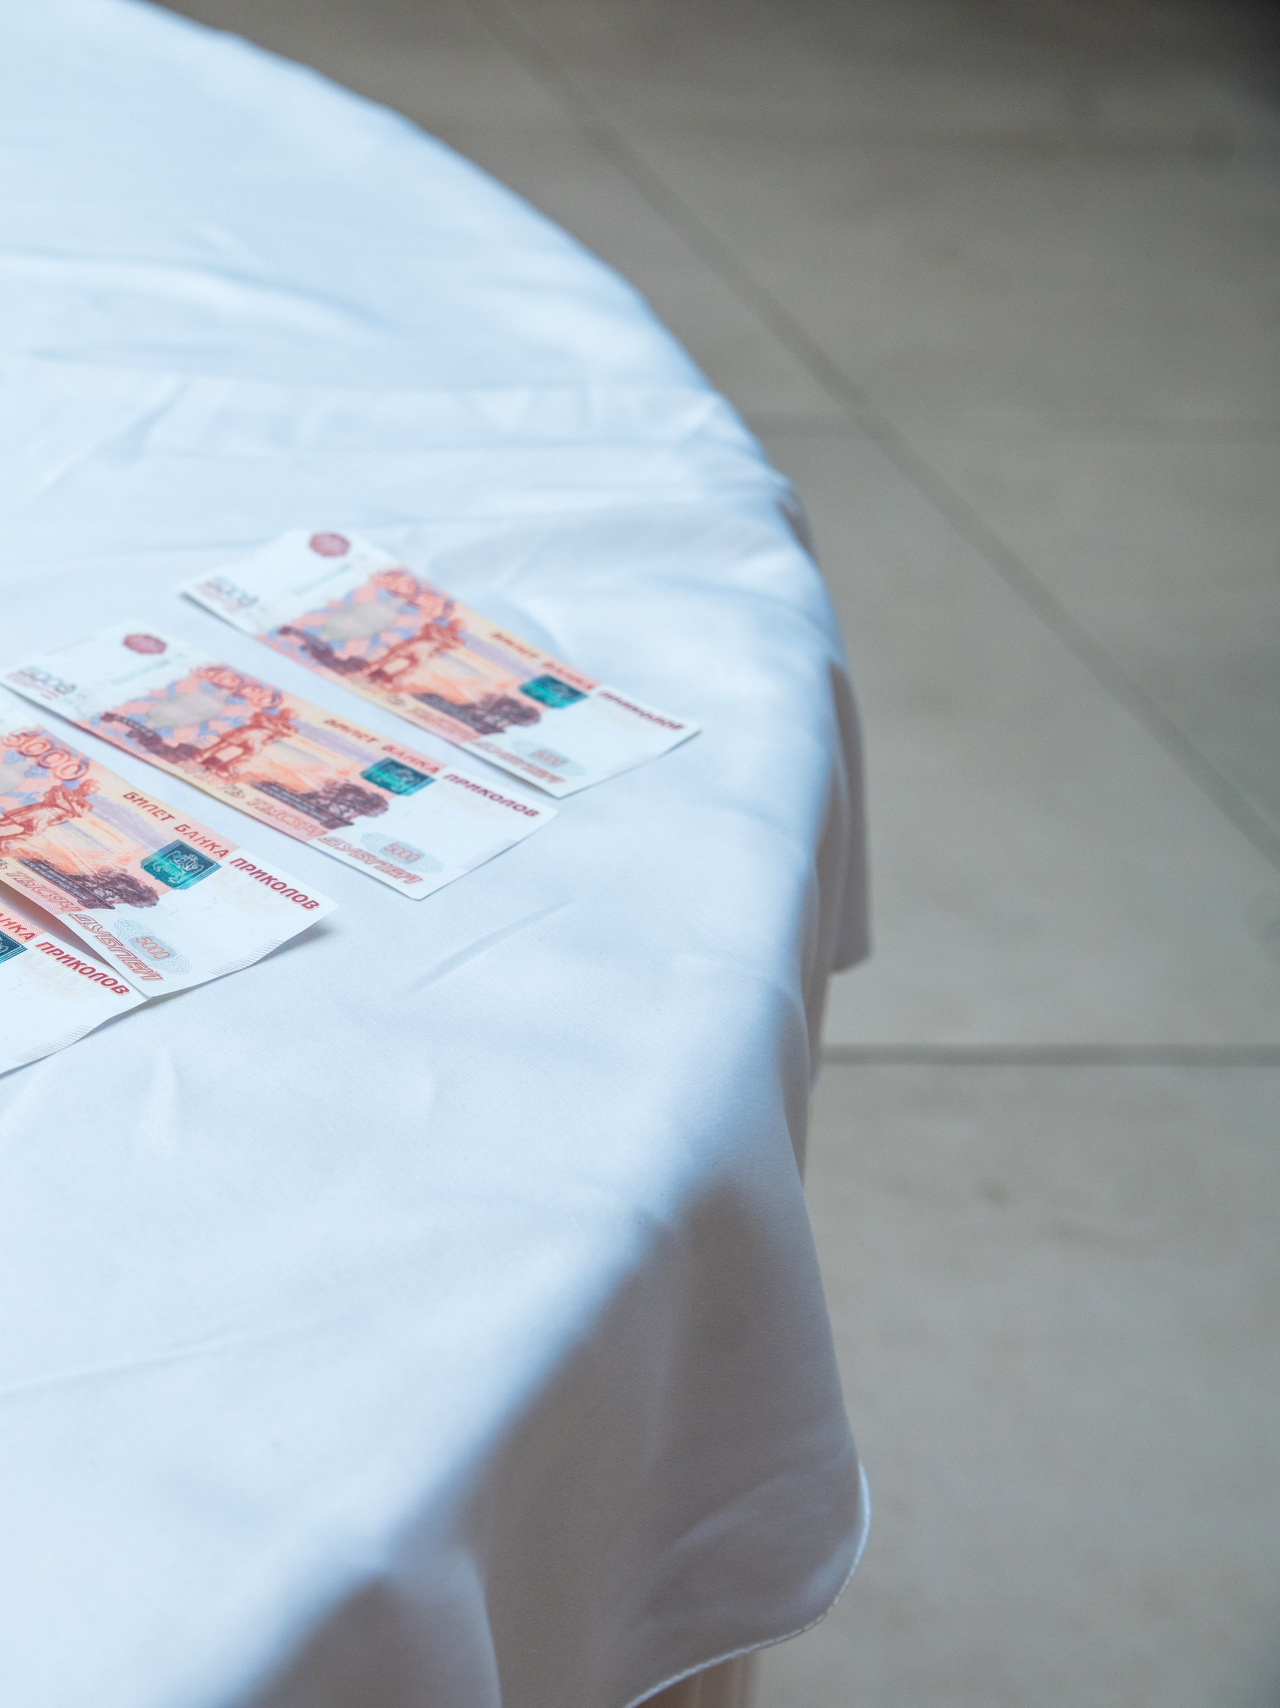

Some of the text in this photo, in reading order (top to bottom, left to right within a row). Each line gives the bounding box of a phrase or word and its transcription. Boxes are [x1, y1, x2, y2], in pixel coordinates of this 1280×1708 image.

[0, 729, 91, 780] 5000
[441, 773, 541, 818] ПРИКОЛОВ
[120, 791, 321, 910] БИЛЕТ БАНКА ПРИКОЛОВ
[382, 842, 423, 864] 5000
[33, 940, 132, 995] ПРИКОЛОВ
[67, 910, 168, 982] ДУБЛЕЙ
[135, 935, 171, 961] 5000
